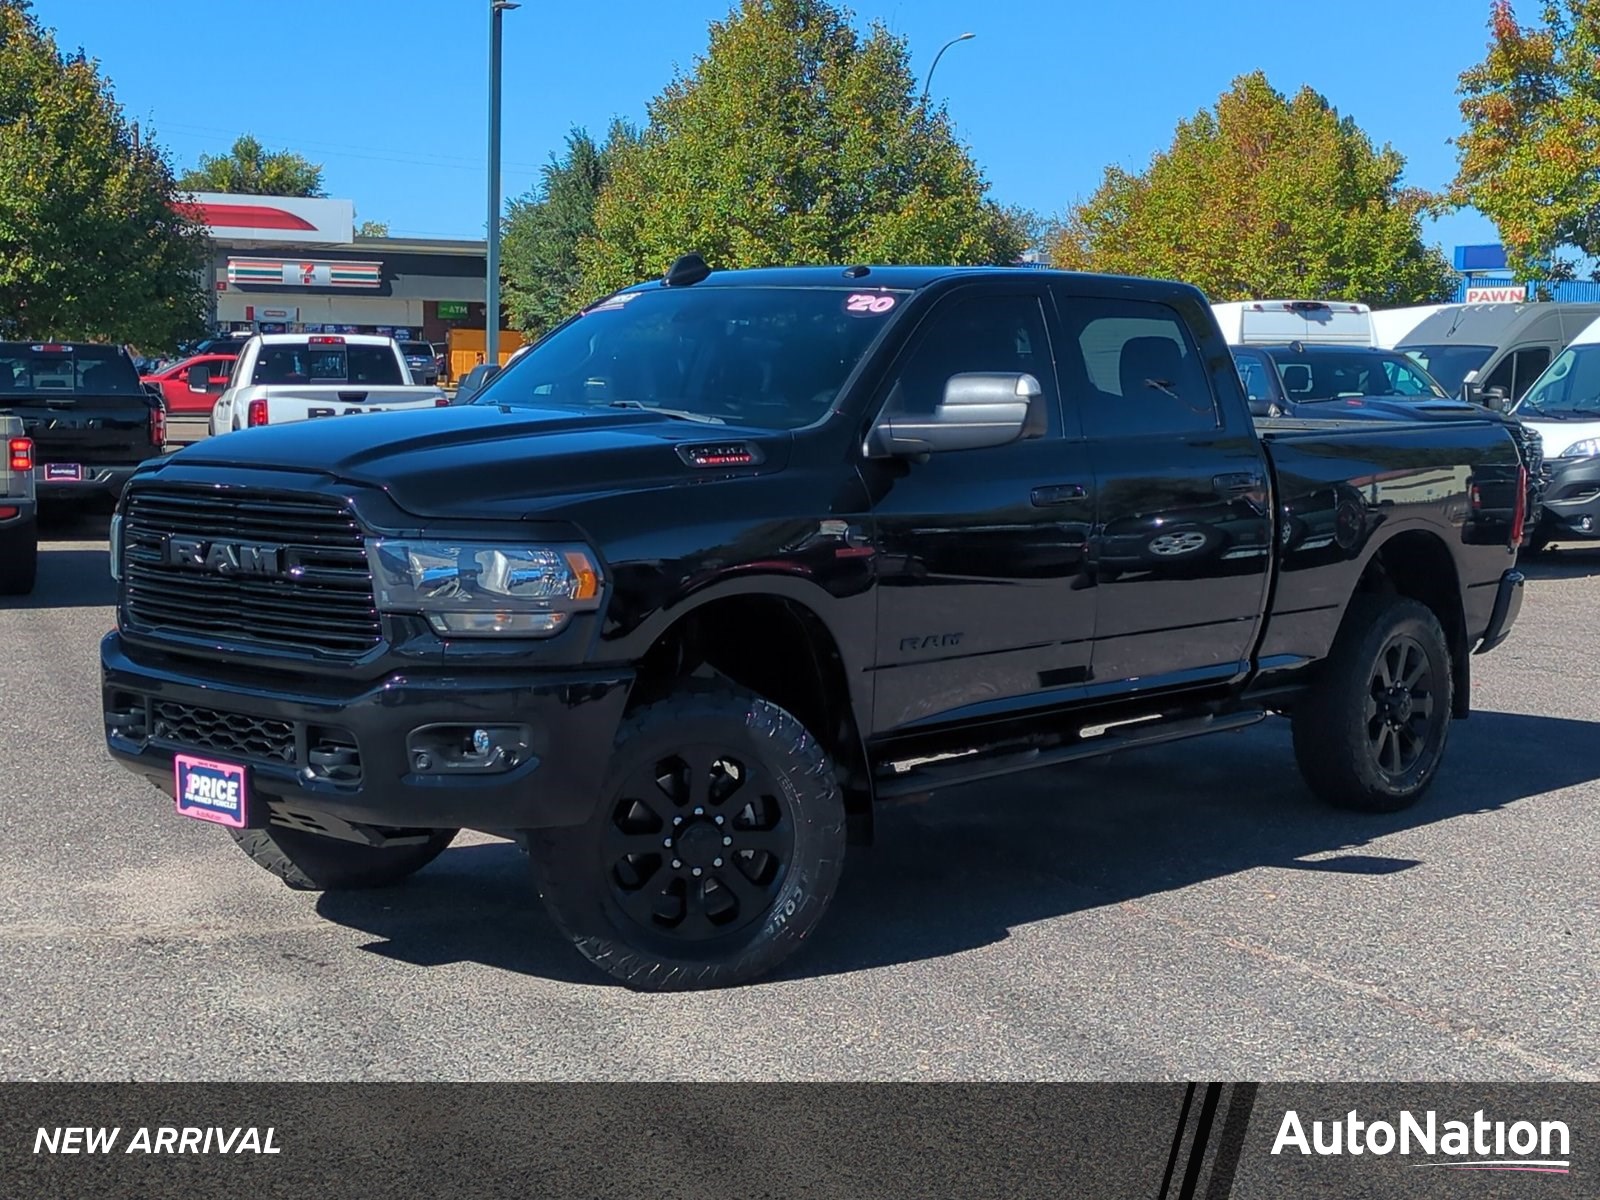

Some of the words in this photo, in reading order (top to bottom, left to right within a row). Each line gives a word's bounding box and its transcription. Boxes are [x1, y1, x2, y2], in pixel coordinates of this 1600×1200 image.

[1468, 289, 1524, 303] PAWN
[448, 305, 468, 314] ATM
[170, 538, 279, 573] RAM
